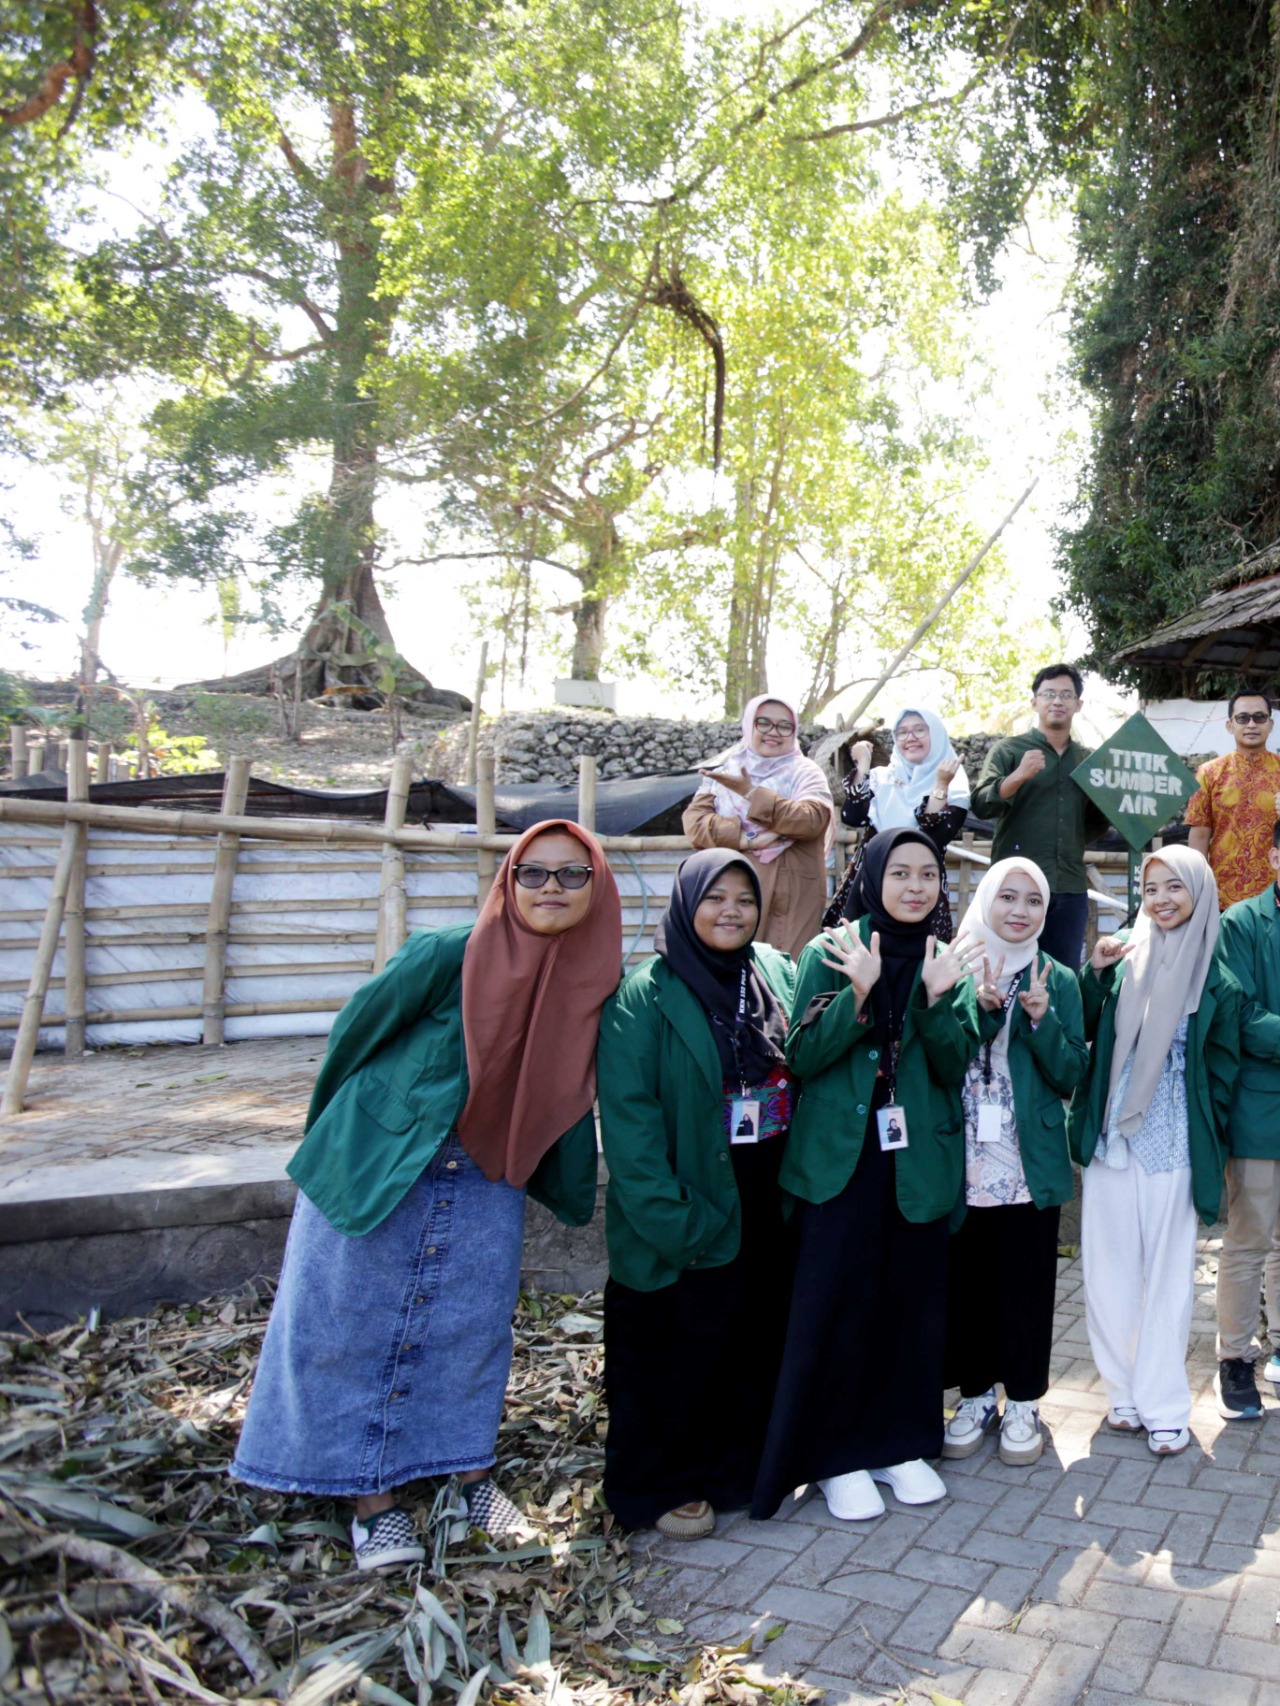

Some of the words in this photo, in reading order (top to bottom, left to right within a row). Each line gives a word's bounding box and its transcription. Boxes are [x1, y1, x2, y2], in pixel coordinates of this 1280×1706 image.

[1108, 748, 1169, 773] TITIK
[1089, 768, 1183, 796] SUMBER
[1118, 794, 1157, 816] AIR
[1009, 979, 1019, 995] PULE
